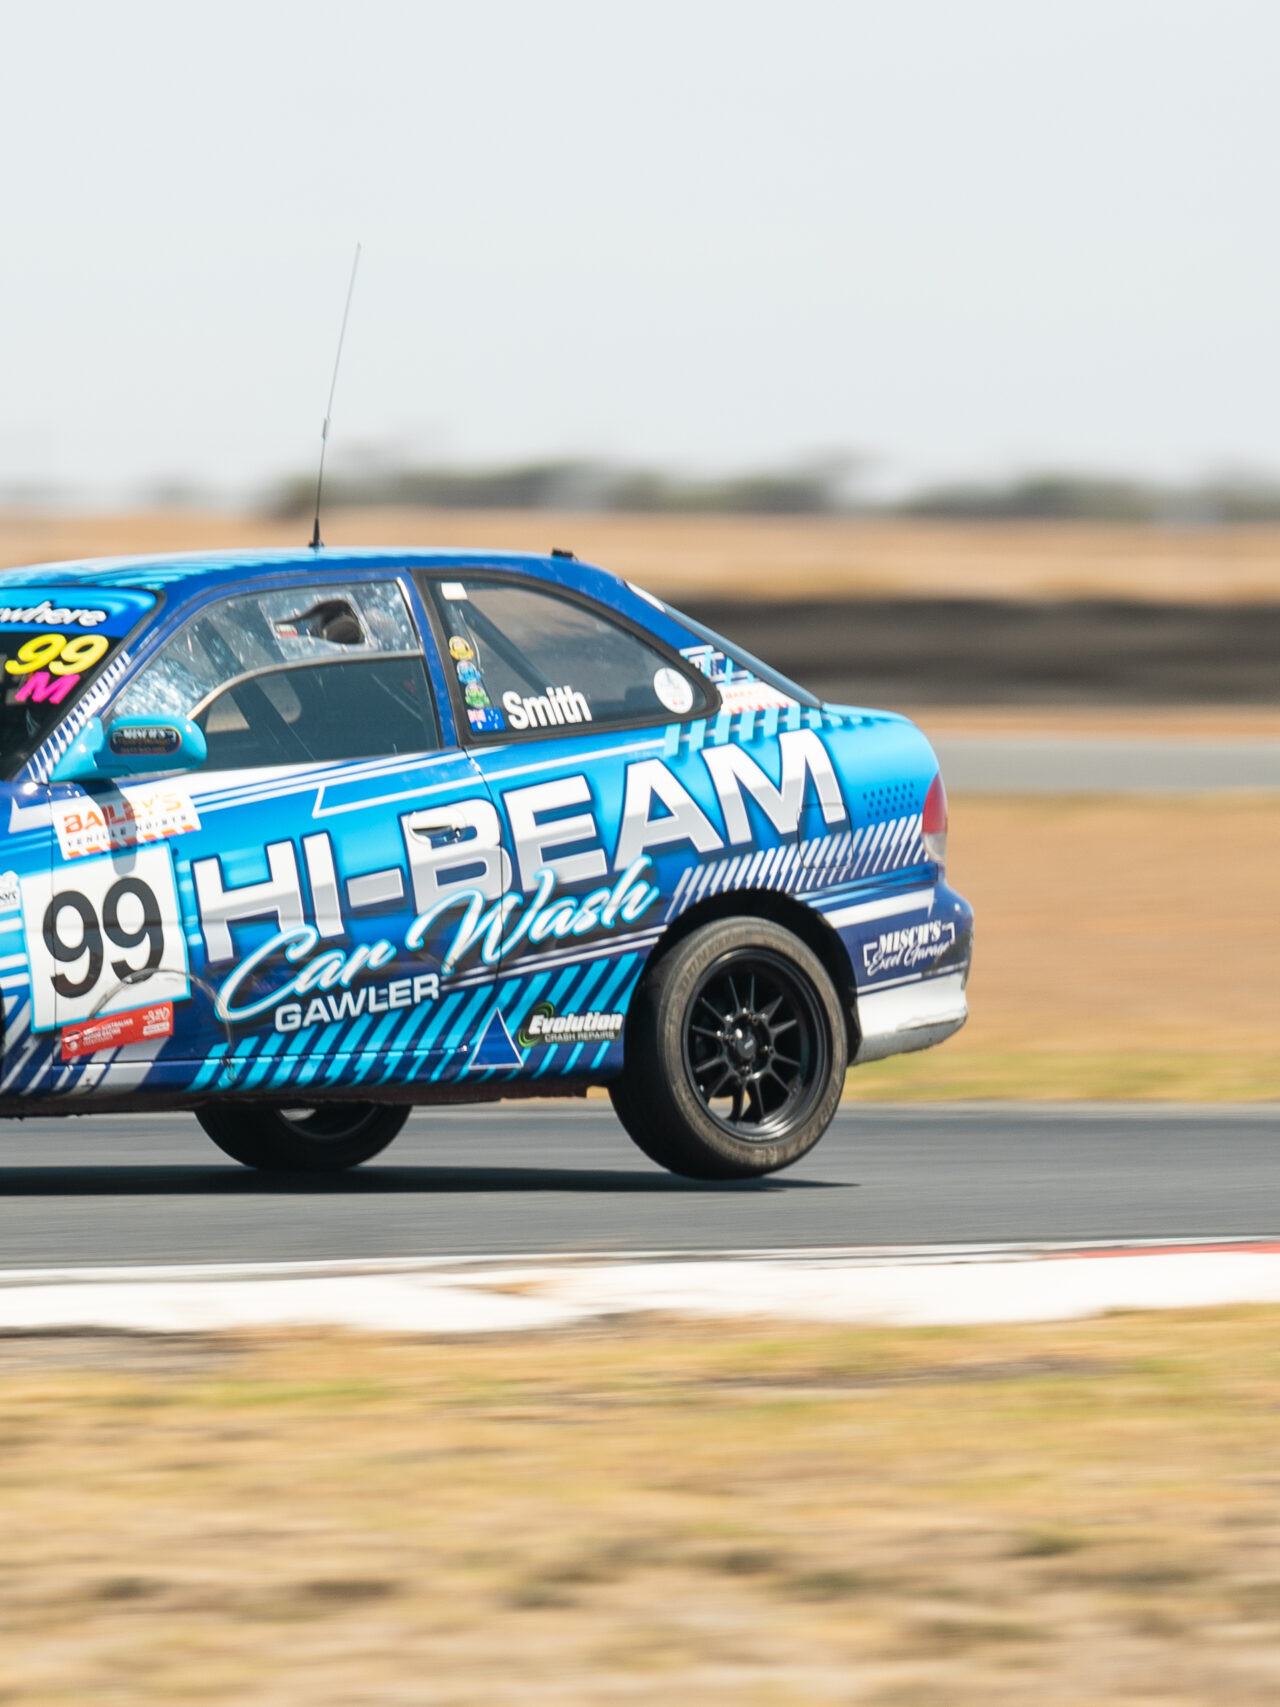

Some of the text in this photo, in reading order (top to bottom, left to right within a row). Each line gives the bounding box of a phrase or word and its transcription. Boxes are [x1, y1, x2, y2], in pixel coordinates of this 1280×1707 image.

[5, 634, 109, 676] 99
[15, 671, 80, 704] M
[502, 685, 592, 730] Smith
[192, 728, 846, 963] HI-BEAM
[42, 877, 164, 998] 99
[215, 925, 397, 1023] Car
[405, 855, 661, 974] Wash
[275, 972, 439, 1033] GAWLER
[528, 1011, 624, 1035] Evolution
[545, 1031, 615, 1042] CRASH REPAIRS
